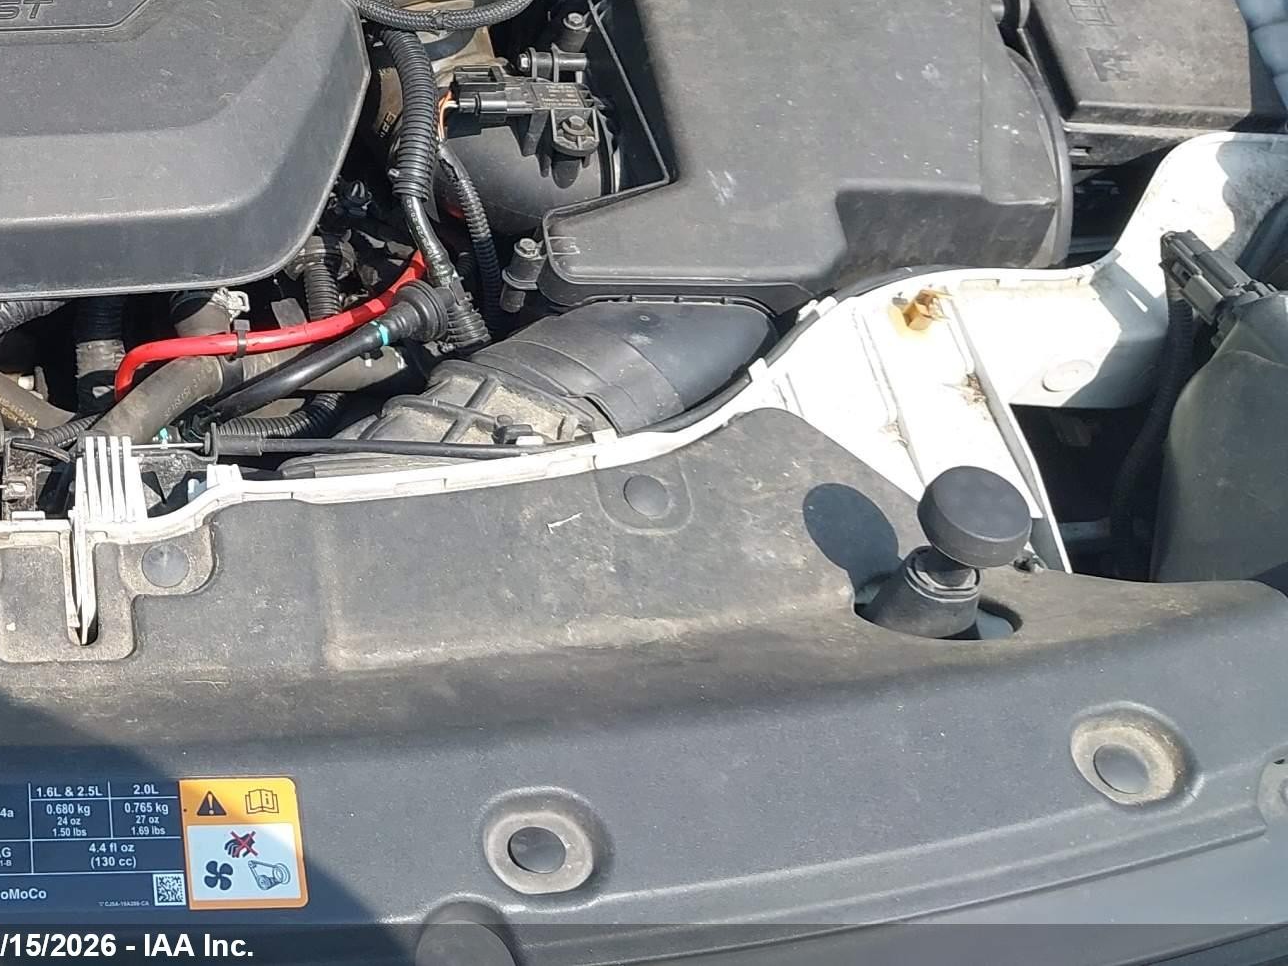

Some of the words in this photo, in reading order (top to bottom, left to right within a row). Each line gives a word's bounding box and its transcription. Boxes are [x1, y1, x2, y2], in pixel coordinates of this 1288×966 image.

[36, 786, 62, 797] 1.6L
[64, 786, 74, 797] &
[77, 785, 103, 796] 2.5L
[133, 784, 159, 795] 2.0L
[46, 804, 74, 815] 0.680
[77, 804, 91, 816] kg
[124, 802, 153, 814] 0.765
[155, 802, 169, 815] kg
[57, 816, 69, 826] 24
[70, 818, 81, 826] oz
[136, 815, 147, 824] 27
[148, 816, 160, 824] oz
[52, 828, 71, 837] 1.50
[73, 827, 87, 837] lbs
[131, 826, 149, 835] 1.69
[152, 825, 166, 835] lbs
[88, 843, 107, 853] 4.4
[109, 842, 117, 853] fl
[120, 844, 135, 853] oz
[91, 856, 115, 870] (130
[119, 856, 137, 869] cc)
